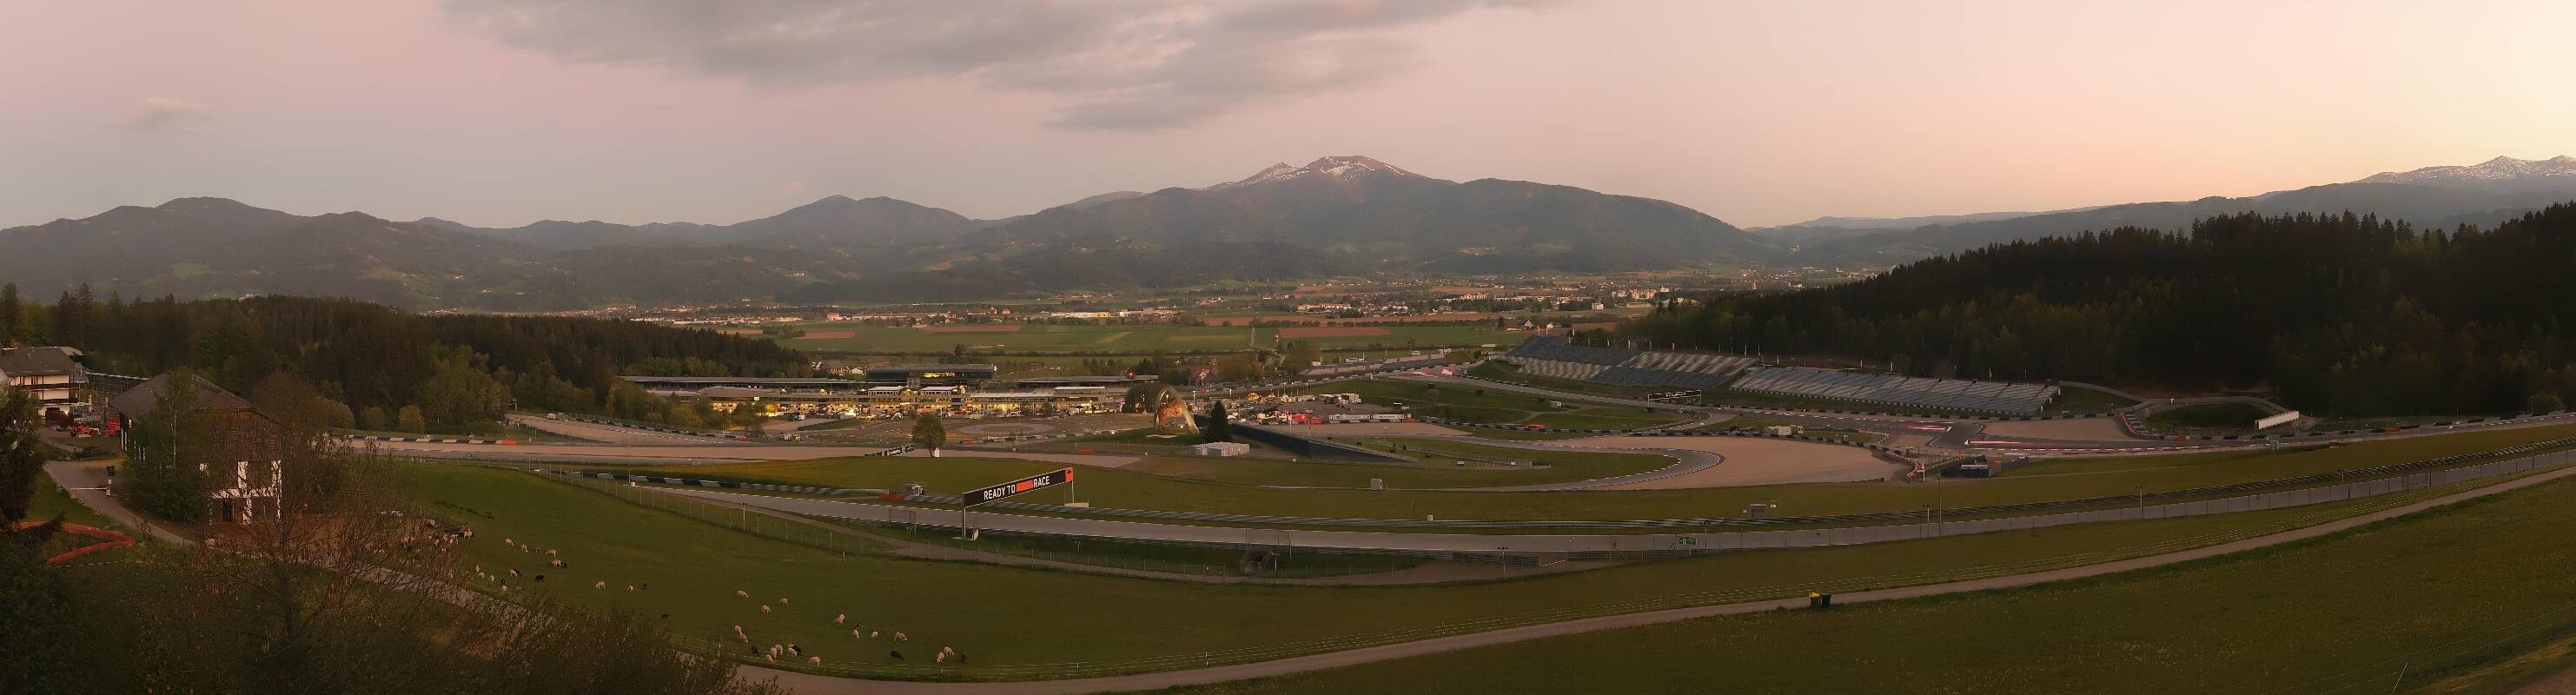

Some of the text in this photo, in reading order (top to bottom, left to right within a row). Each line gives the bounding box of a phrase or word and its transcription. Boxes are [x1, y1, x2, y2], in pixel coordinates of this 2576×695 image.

[983, 475, 1050, 500] READY TO RACE
